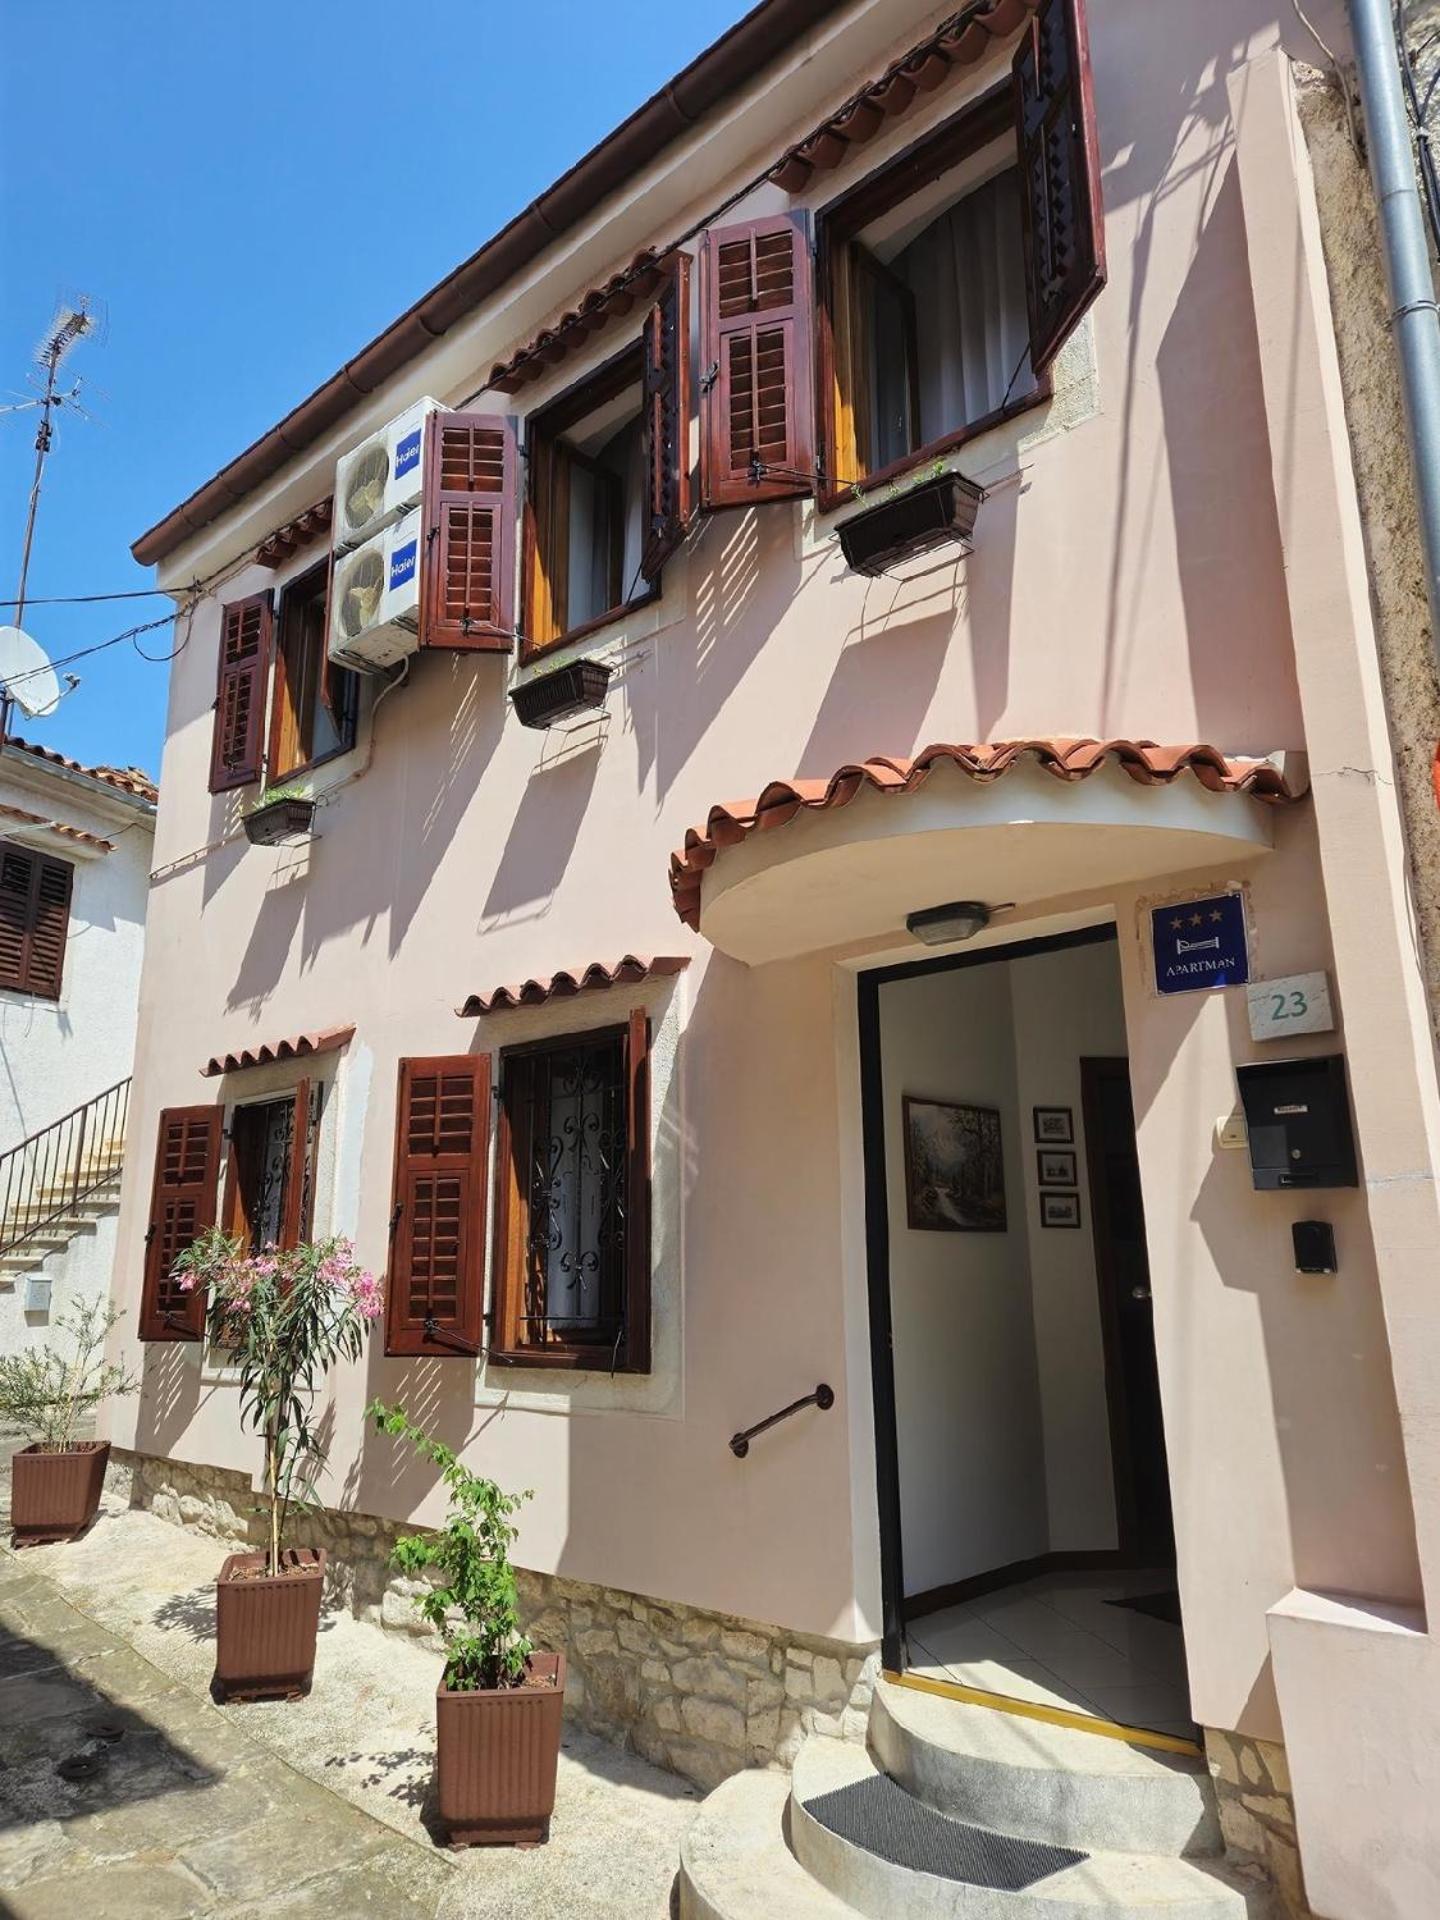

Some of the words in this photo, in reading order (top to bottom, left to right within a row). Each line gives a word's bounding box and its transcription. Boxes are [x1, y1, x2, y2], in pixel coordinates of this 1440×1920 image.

[396, 444, 419, 468] Haier
[391, 555, 415, 577] Haier
[1166, 957, 1235, 977] APARTMAN
[1271, 991, 1307, 1021] 23
